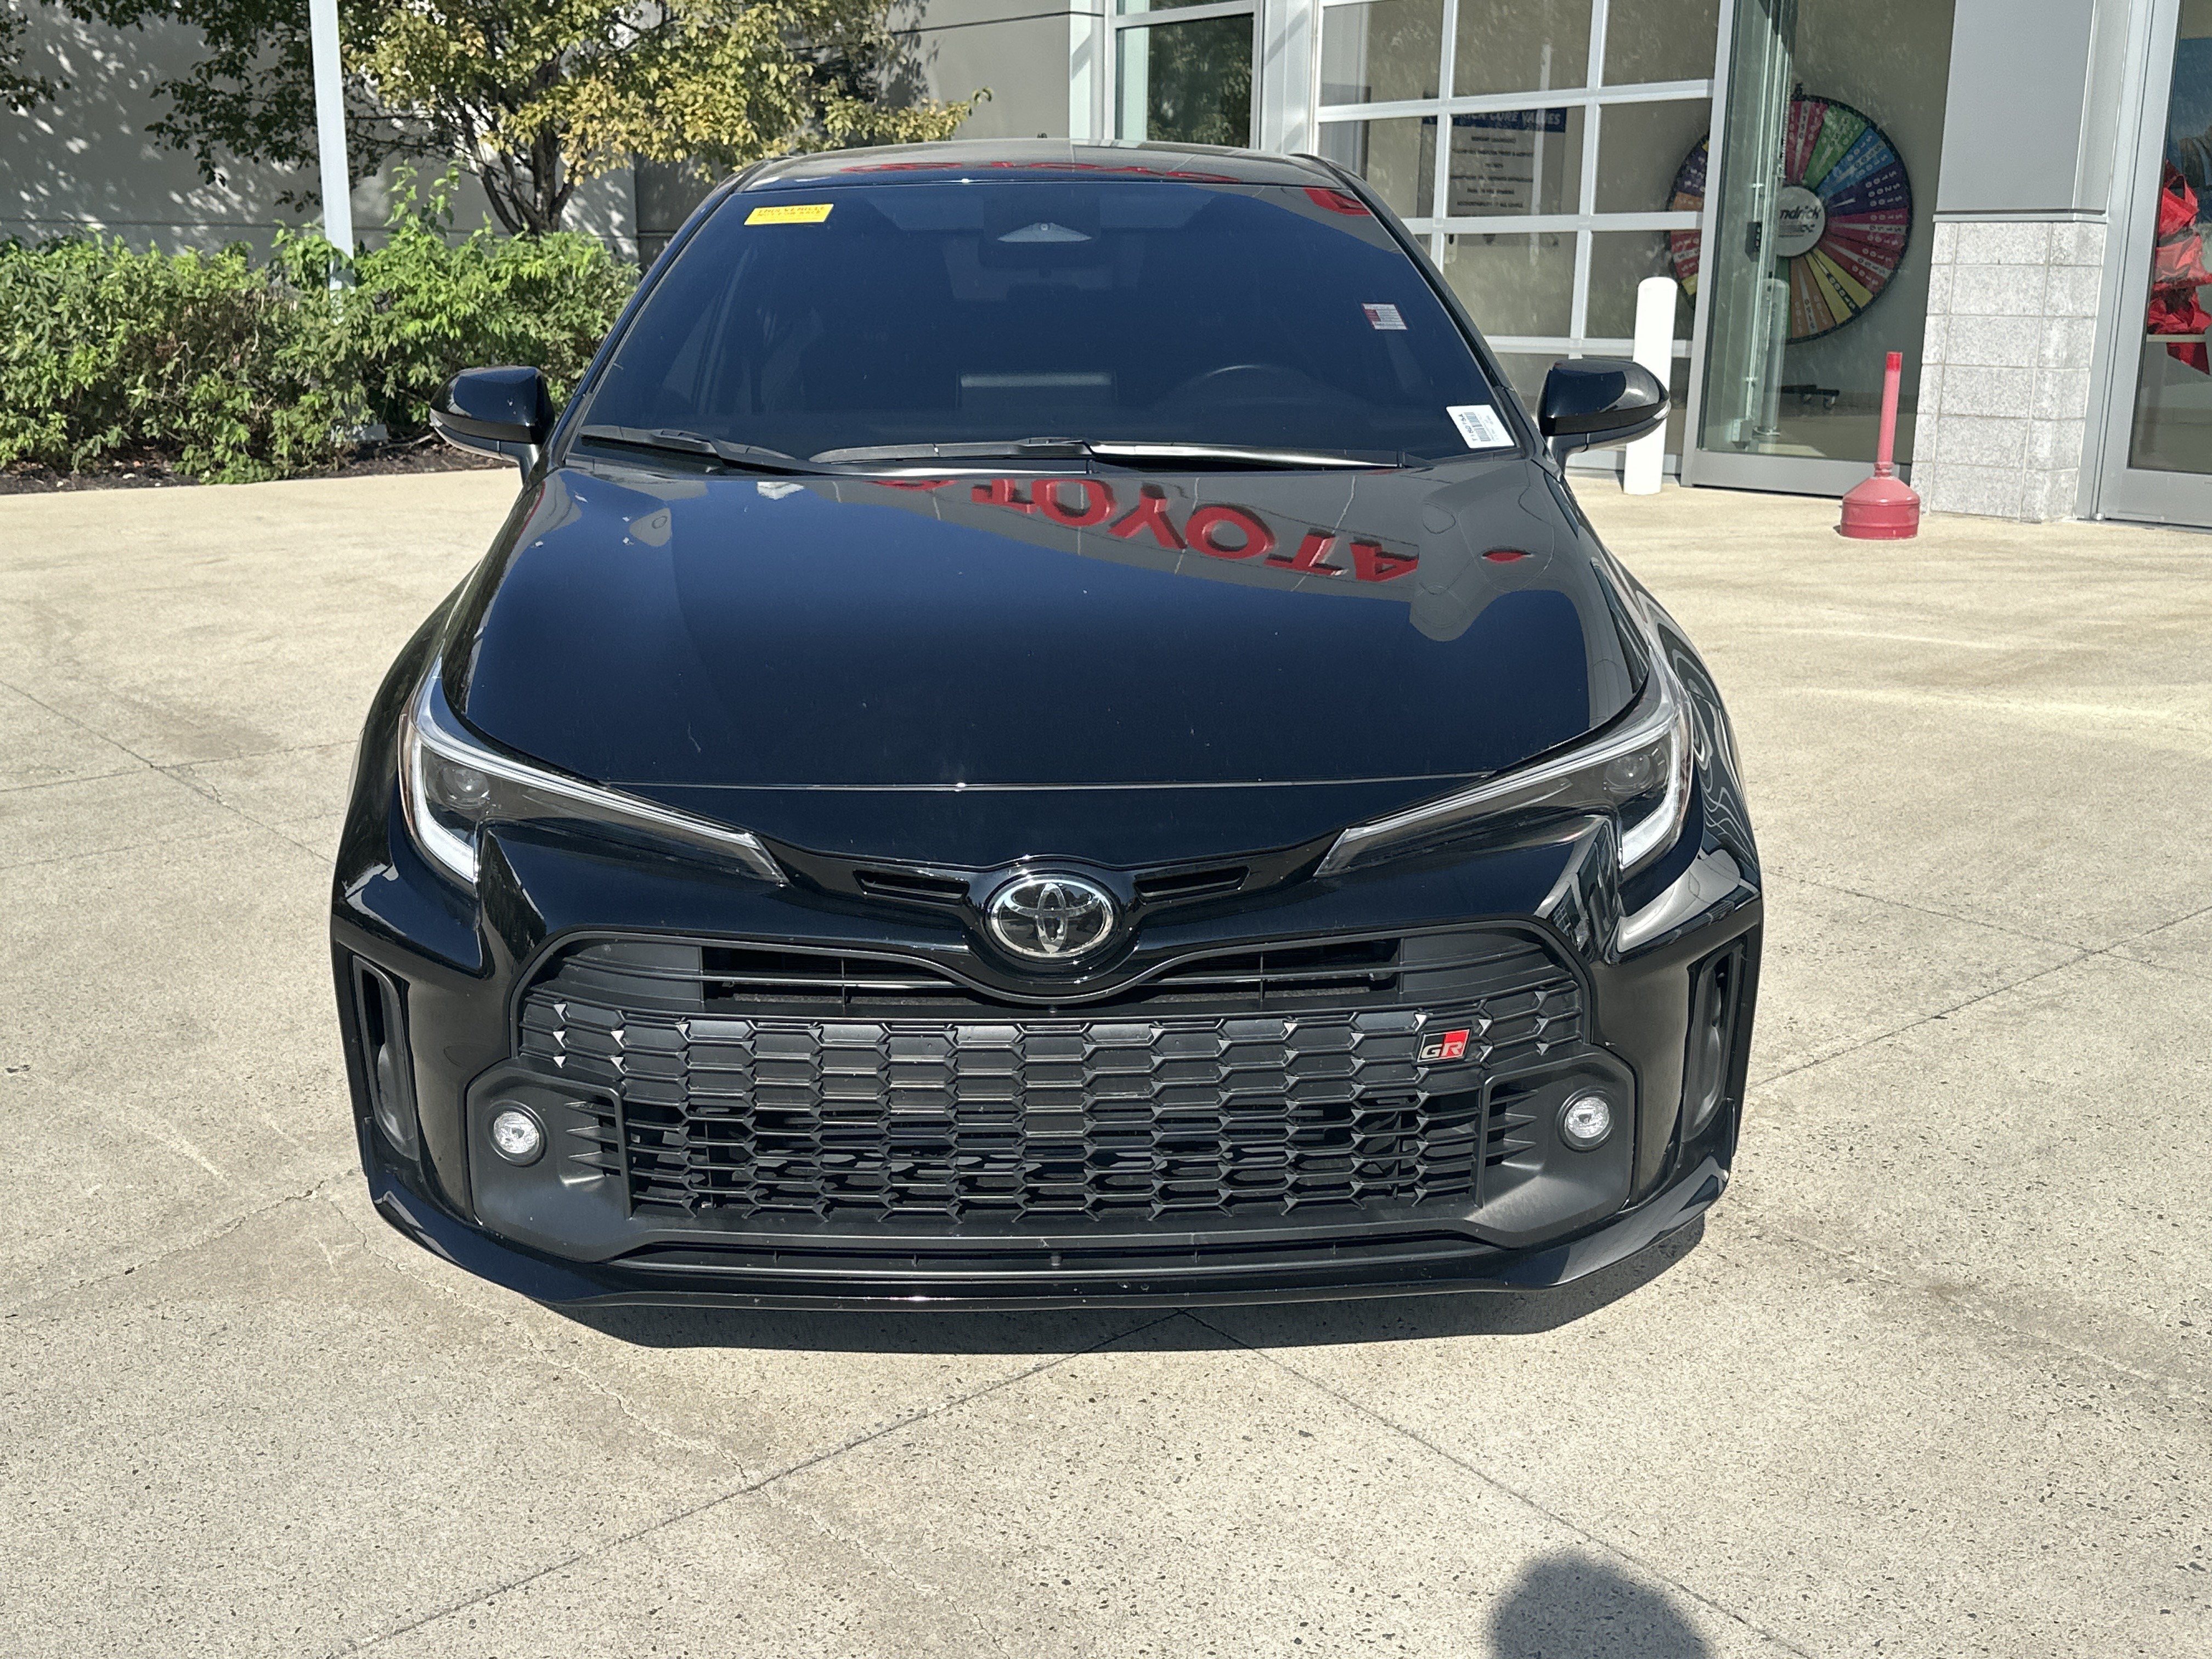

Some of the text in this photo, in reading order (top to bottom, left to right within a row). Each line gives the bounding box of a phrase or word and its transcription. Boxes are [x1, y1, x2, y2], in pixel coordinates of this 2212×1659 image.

[1521, 111, 1561, 125] VAES
[1780, 206, 1821, 219] ndrick
[1421, 1041, 1463, 1059] GR
